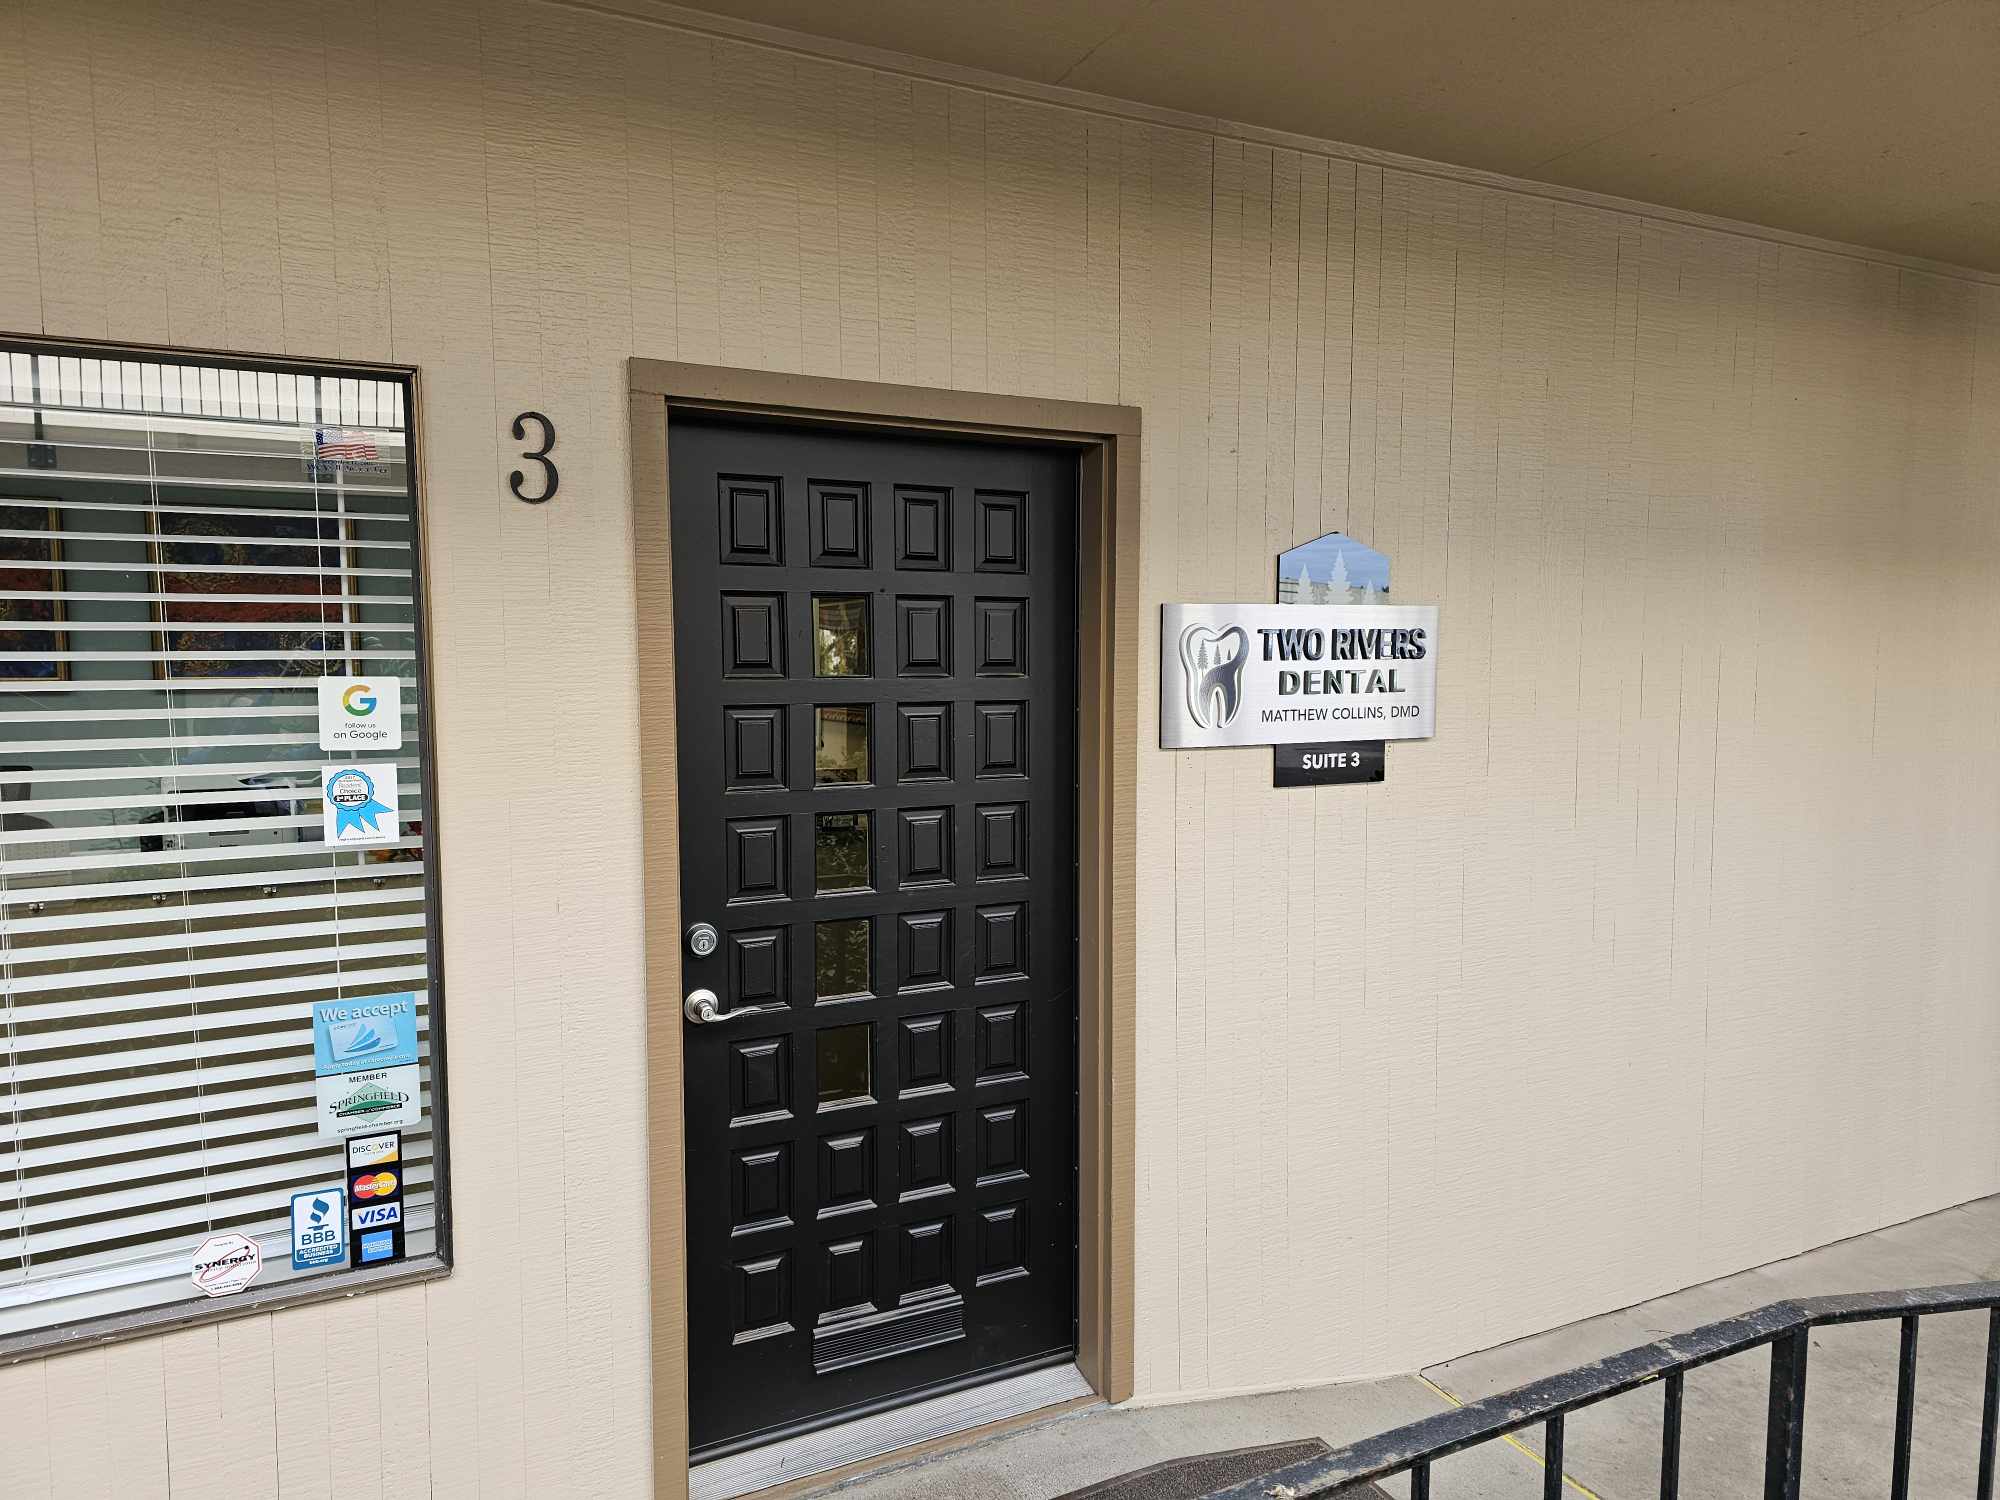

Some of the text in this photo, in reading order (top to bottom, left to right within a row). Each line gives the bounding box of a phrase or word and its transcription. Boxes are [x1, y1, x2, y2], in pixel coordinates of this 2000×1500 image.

[509, 411, 559, 505] 3
[1257, 628, 1427, 661] TWO RIVERS
[1278, 669, 1406, 696] DENTAL
[1261, 705, 1420, 724] MATTHEW COLLINS, DMD
[333, 730, 388, 741] on Google
[1302, 751, 1361, 770] SUITE 3
[320, 1000, 409, 1023] We accept
[349, 1072, 388, 1083] MEMBER
[329, 1091, 410, 1114] SPRINGFIELD
[352, 1141, 395, 1154] DISCOVER
[354, 1180, 398, 1193] MasterCard
[358, 1207, 398, 1225] VISA
[301, 1230, 336, 1246] BBB
[195, 1254, 256, 1271] SYNERGY
[303, 1250, 334, 1259] BUSINESS
